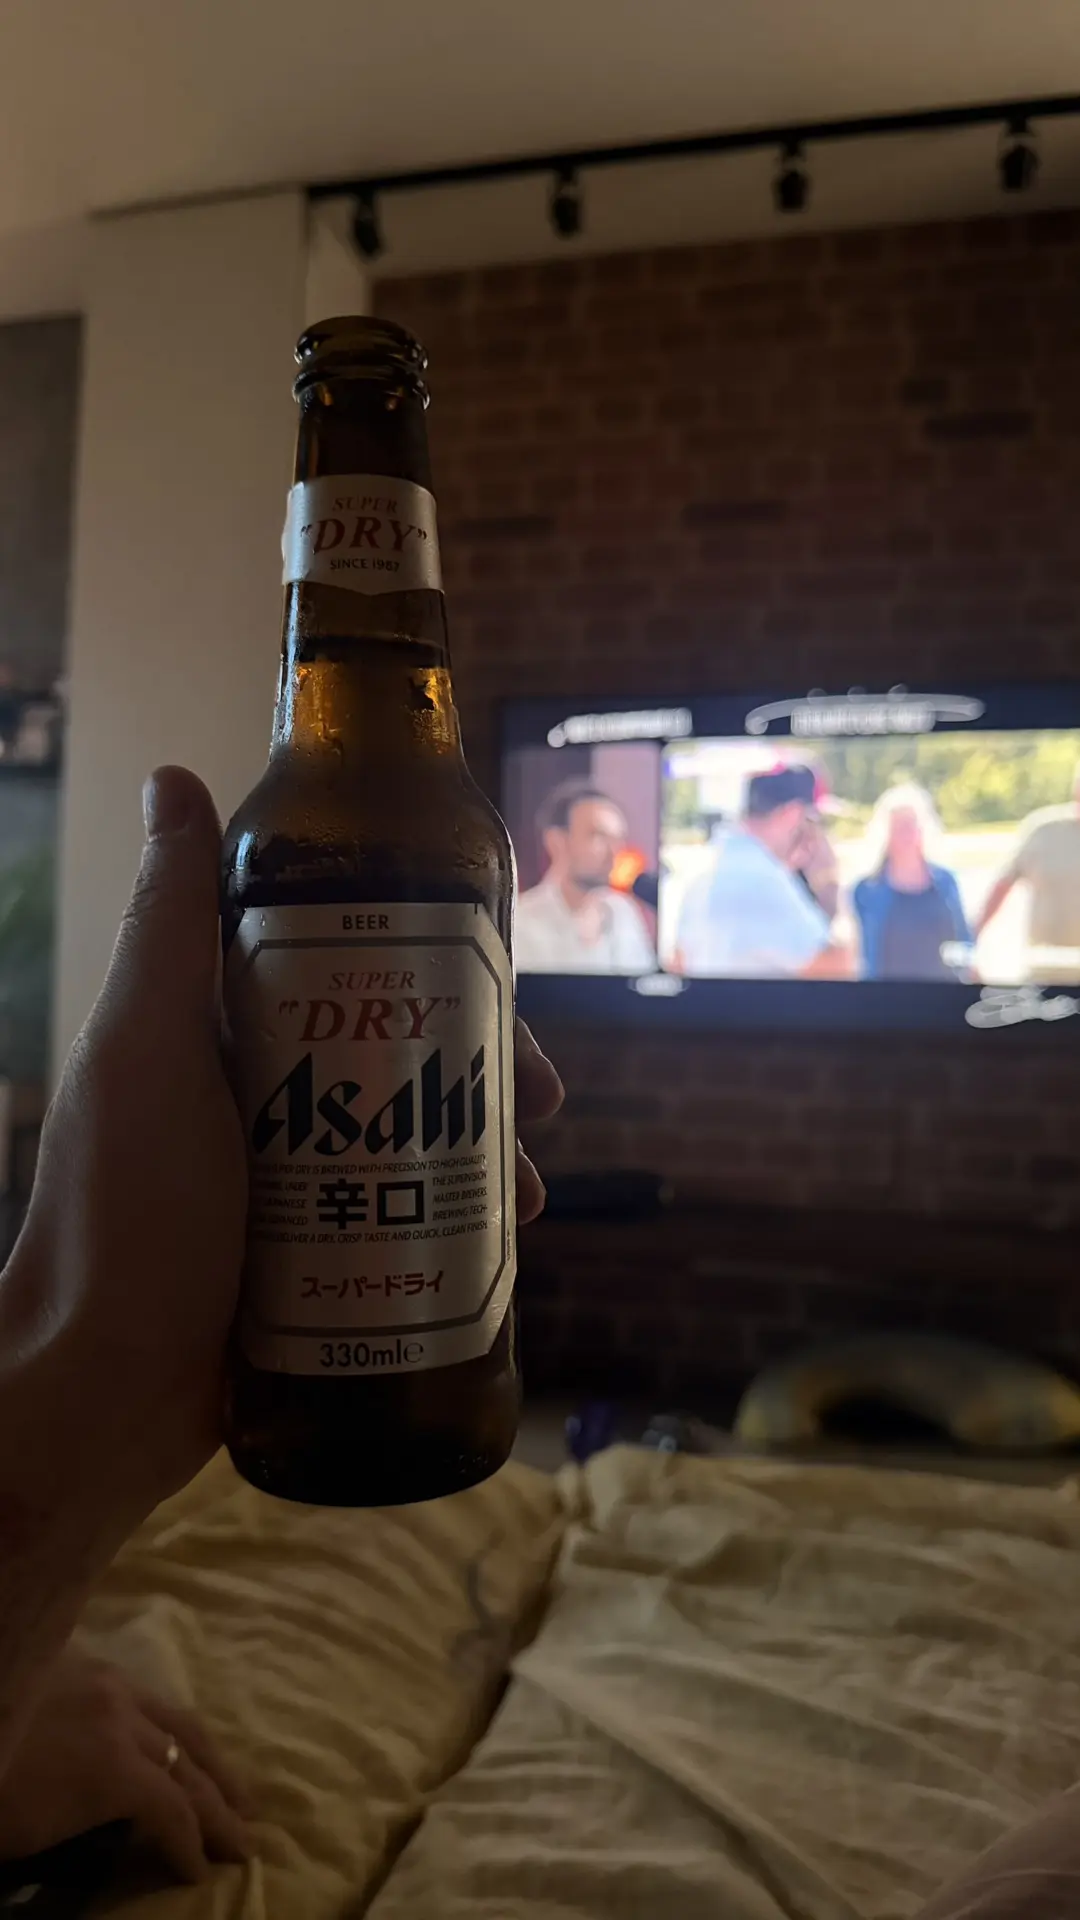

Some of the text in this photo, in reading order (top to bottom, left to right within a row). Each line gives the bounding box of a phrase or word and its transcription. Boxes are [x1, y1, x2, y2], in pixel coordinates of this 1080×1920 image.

[333, 496, 398, 514] SUPER
[330, 558, 400, 573] SINCE 1987
[342, 914, 390, 930] BEER
[327, 970, 416, 991] SUPER
[252, 1044, 486, 1156] Asahi
[320, 1163, 358, 1175] BREWED
[358, 1162, 381, 1174] WITH
[382, 1161, 427, 1173] PRECISION
[428, 1160, 439, 1170] TO
[316, 1178, 424, 1230] 辛口
[432, 1207, 468, 1220] BREWING
[364, 1232, 390, 1243] TASTE
[391, 1230, 411, 1241] AND
[442, 1223, 466, 1237] CLEAN
[300, 1270, 444, 1299] スーパードライ
